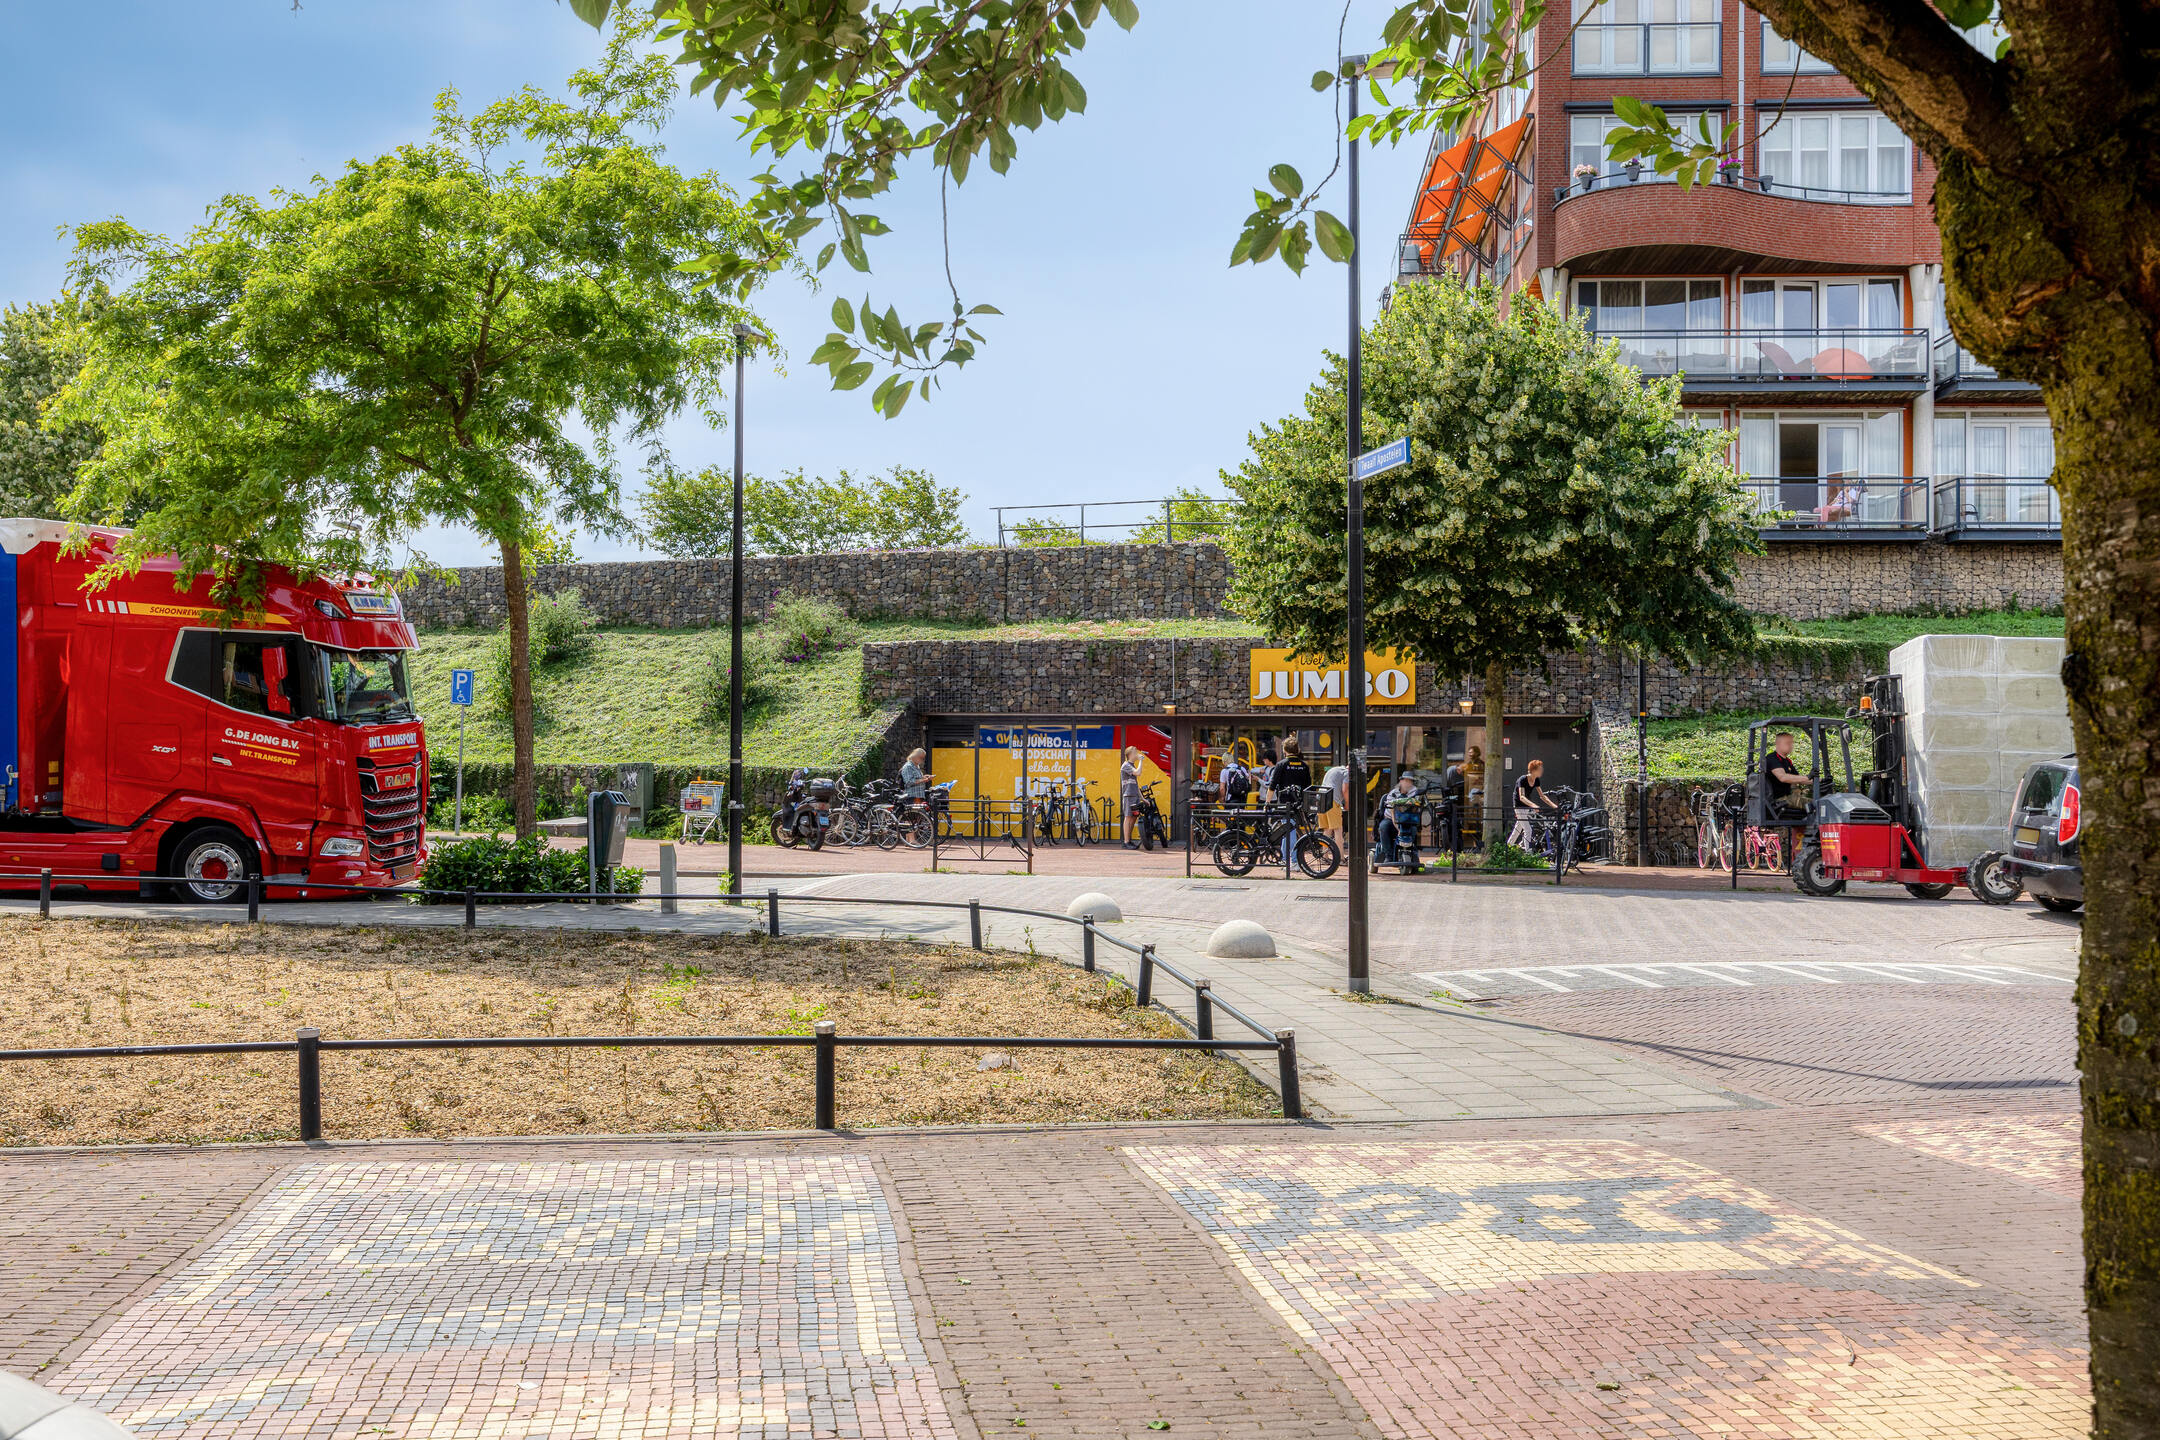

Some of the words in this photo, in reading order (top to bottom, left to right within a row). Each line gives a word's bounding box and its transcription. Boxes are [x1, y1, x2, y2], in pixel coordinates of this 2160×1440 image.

[149, 606, 219, 619] SCHOONREW
[456, 673, 468, 689] P
[251, 733, 279, 746] JONG
[281, 739, 299, 750] B.V.
[368, 735, 382, 748] INT.
[383, 732, 417, 747] TRANSPORT
[1027, 736, 1061, 748] JUMBO
[240, 749, 254, 758] INT.
[254, 752, 296, 766] TRANSPORT
[1012, 749, 1086, 760] BOODSCHAPEN
[1029, 761, 1050, 773] elke
[1051, 761, 1071, 776] dag
[296, 841, 303, 850] 2
